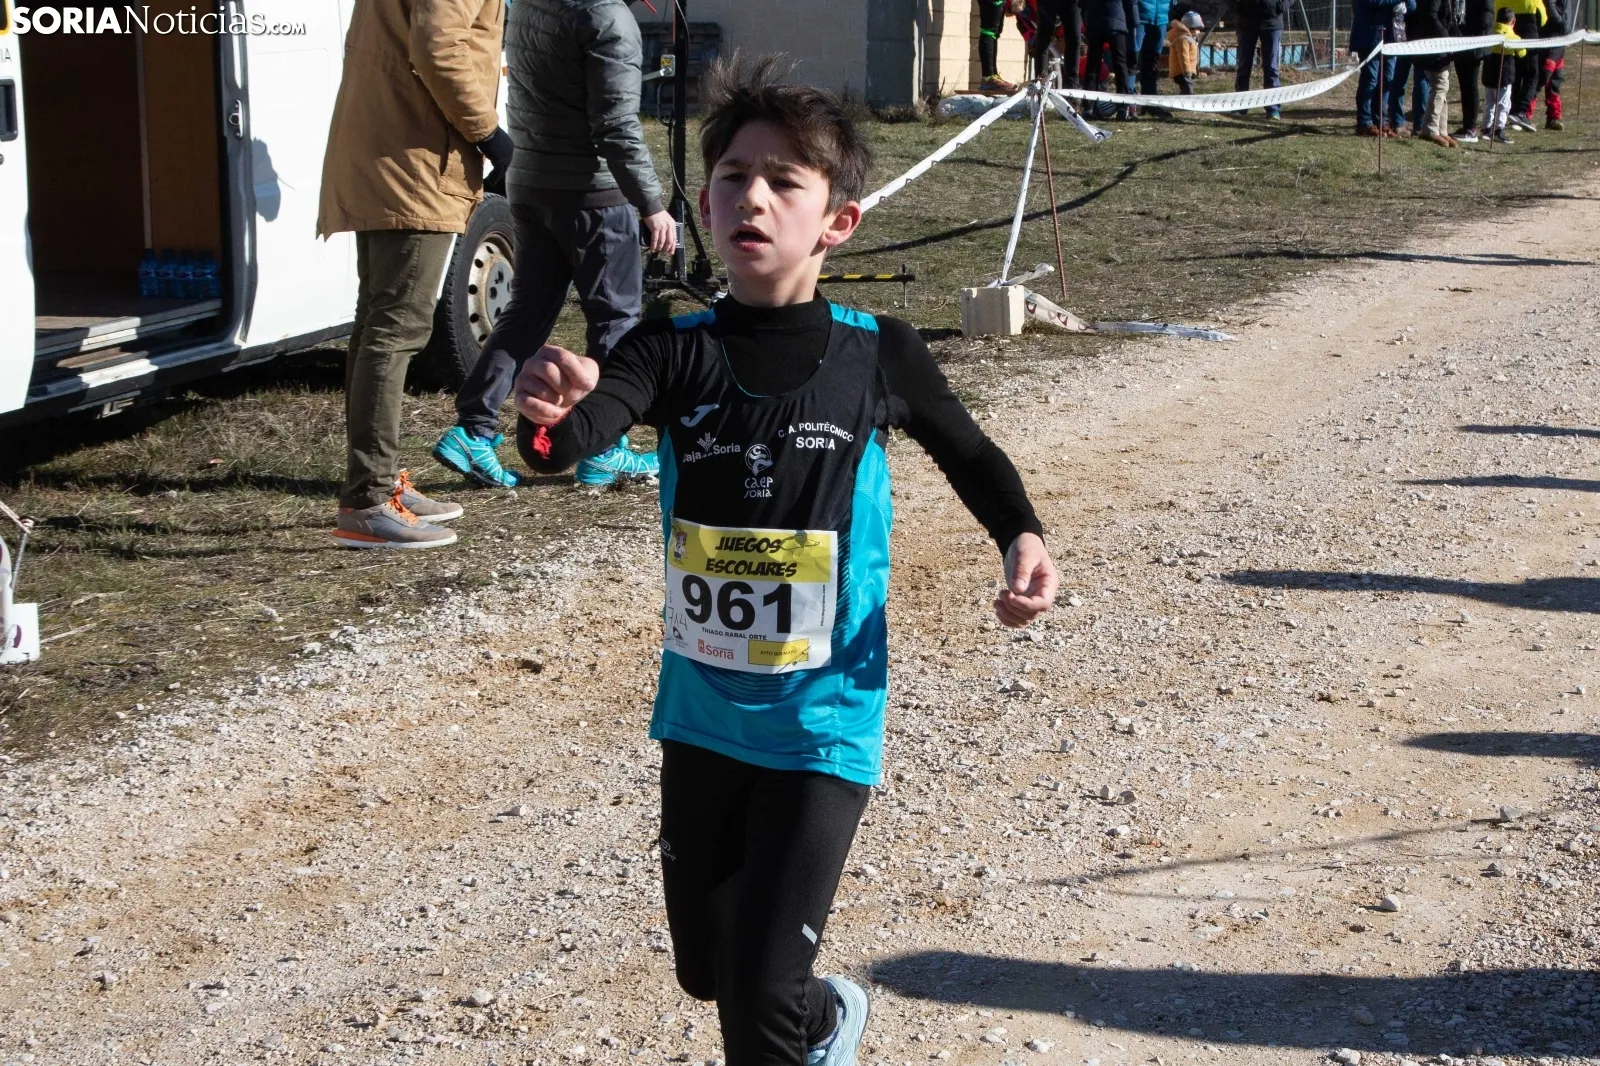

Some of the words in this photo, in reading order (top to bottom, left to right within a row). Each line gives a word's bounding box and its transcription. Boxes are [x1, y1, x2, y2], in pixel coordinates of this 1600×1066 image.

[798, 421, 854, 442] POLITÉCNICO
[712, 443, 741, 455] Soria
[795, 436, 836, 450] SORIA
[715, 536, 782, 554] JUEGOS
[705, 558, 798, 578] ESCOLARES
[682, 574, 792, 634] 961
[701, 626, 724, 637] THIAGO
[725, 631, 748, 640] RABAL
[705, 644, 734, 660] Soria
